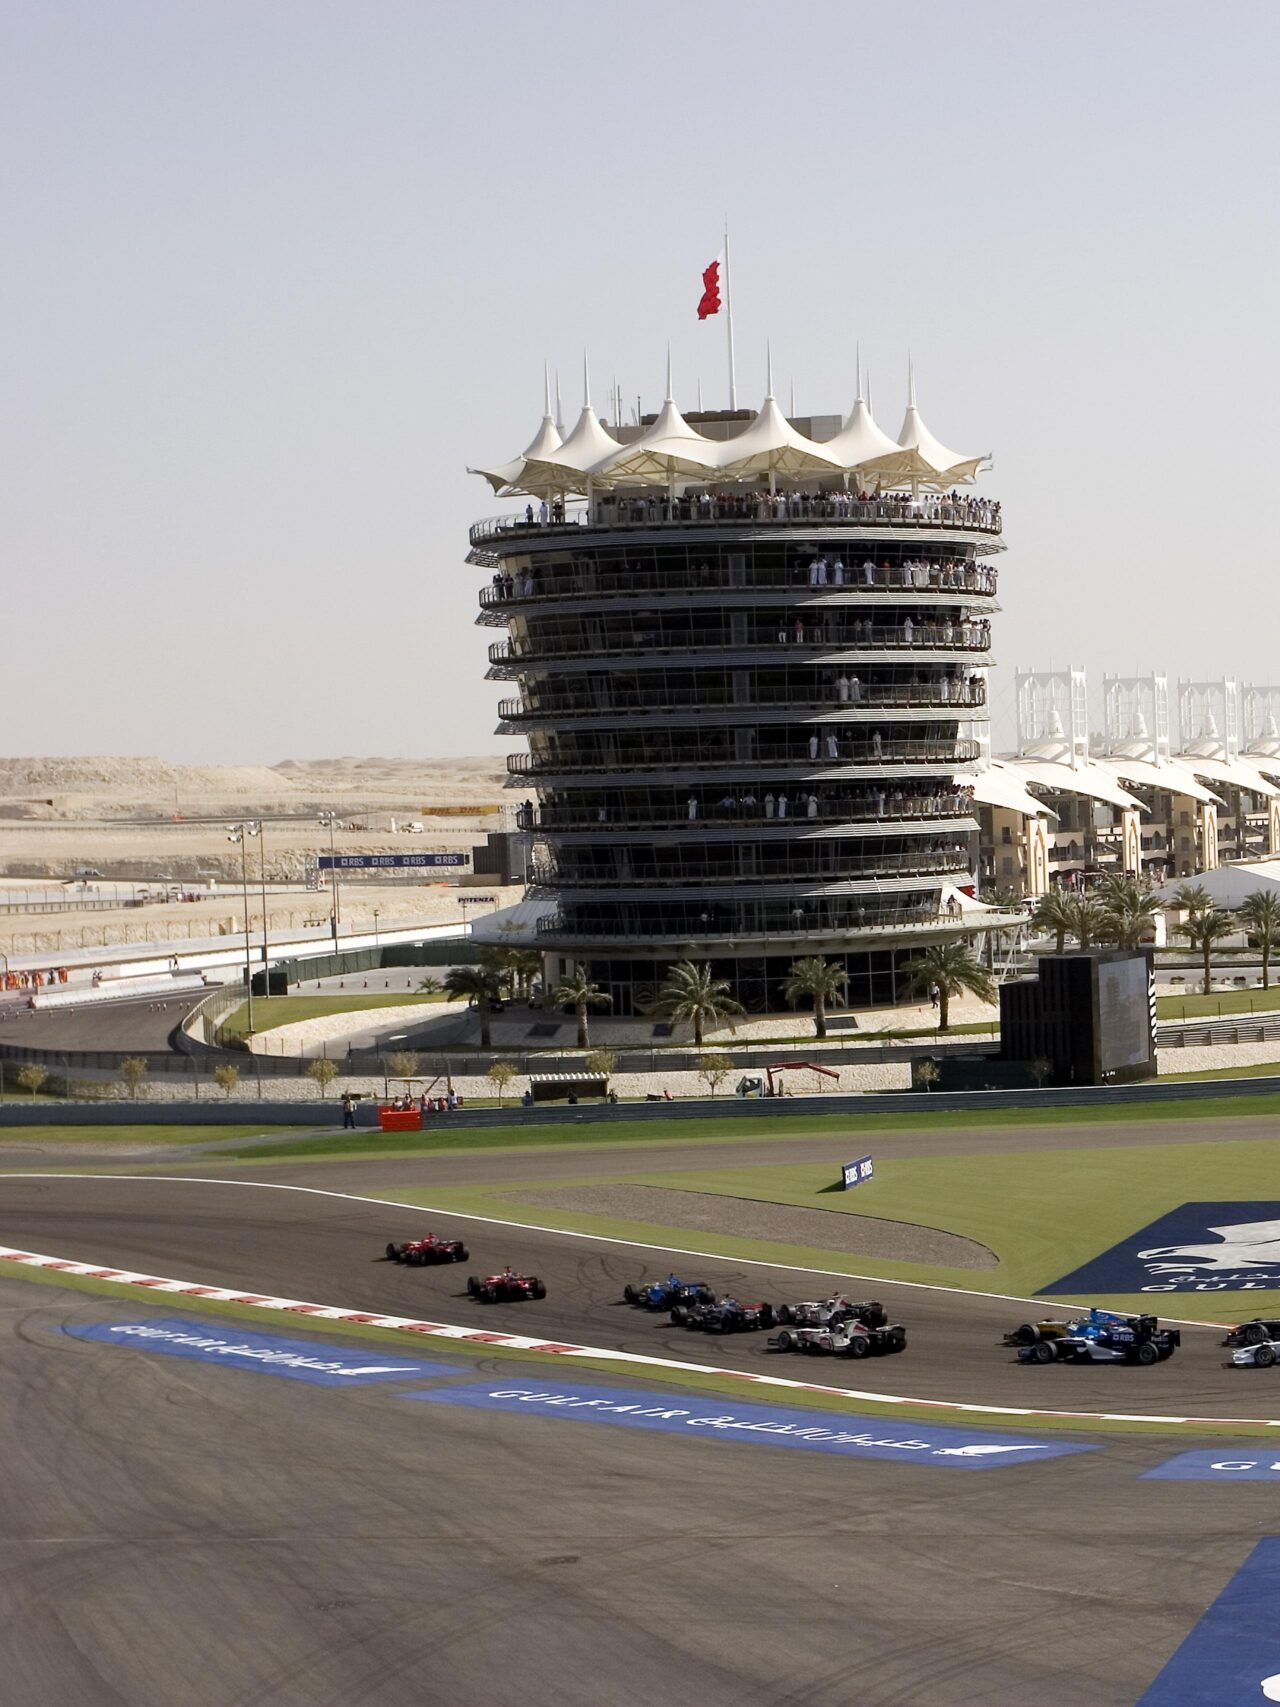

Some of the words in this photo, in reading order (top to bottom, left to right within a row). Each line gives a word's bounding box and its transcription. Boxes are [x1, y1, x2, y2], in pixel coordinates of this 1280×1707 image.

[349, 858, 364, 867] RBS
[379, 857, 395, 866] RBS
[410, 856, 426, 865] RBS
[442, 855, 458, 864] RBS
[1120, 1333, 1135, 1342] RBS
[489, 1389, 615, 1407] GULF
[597, 1404, 691, 1419] AIR
